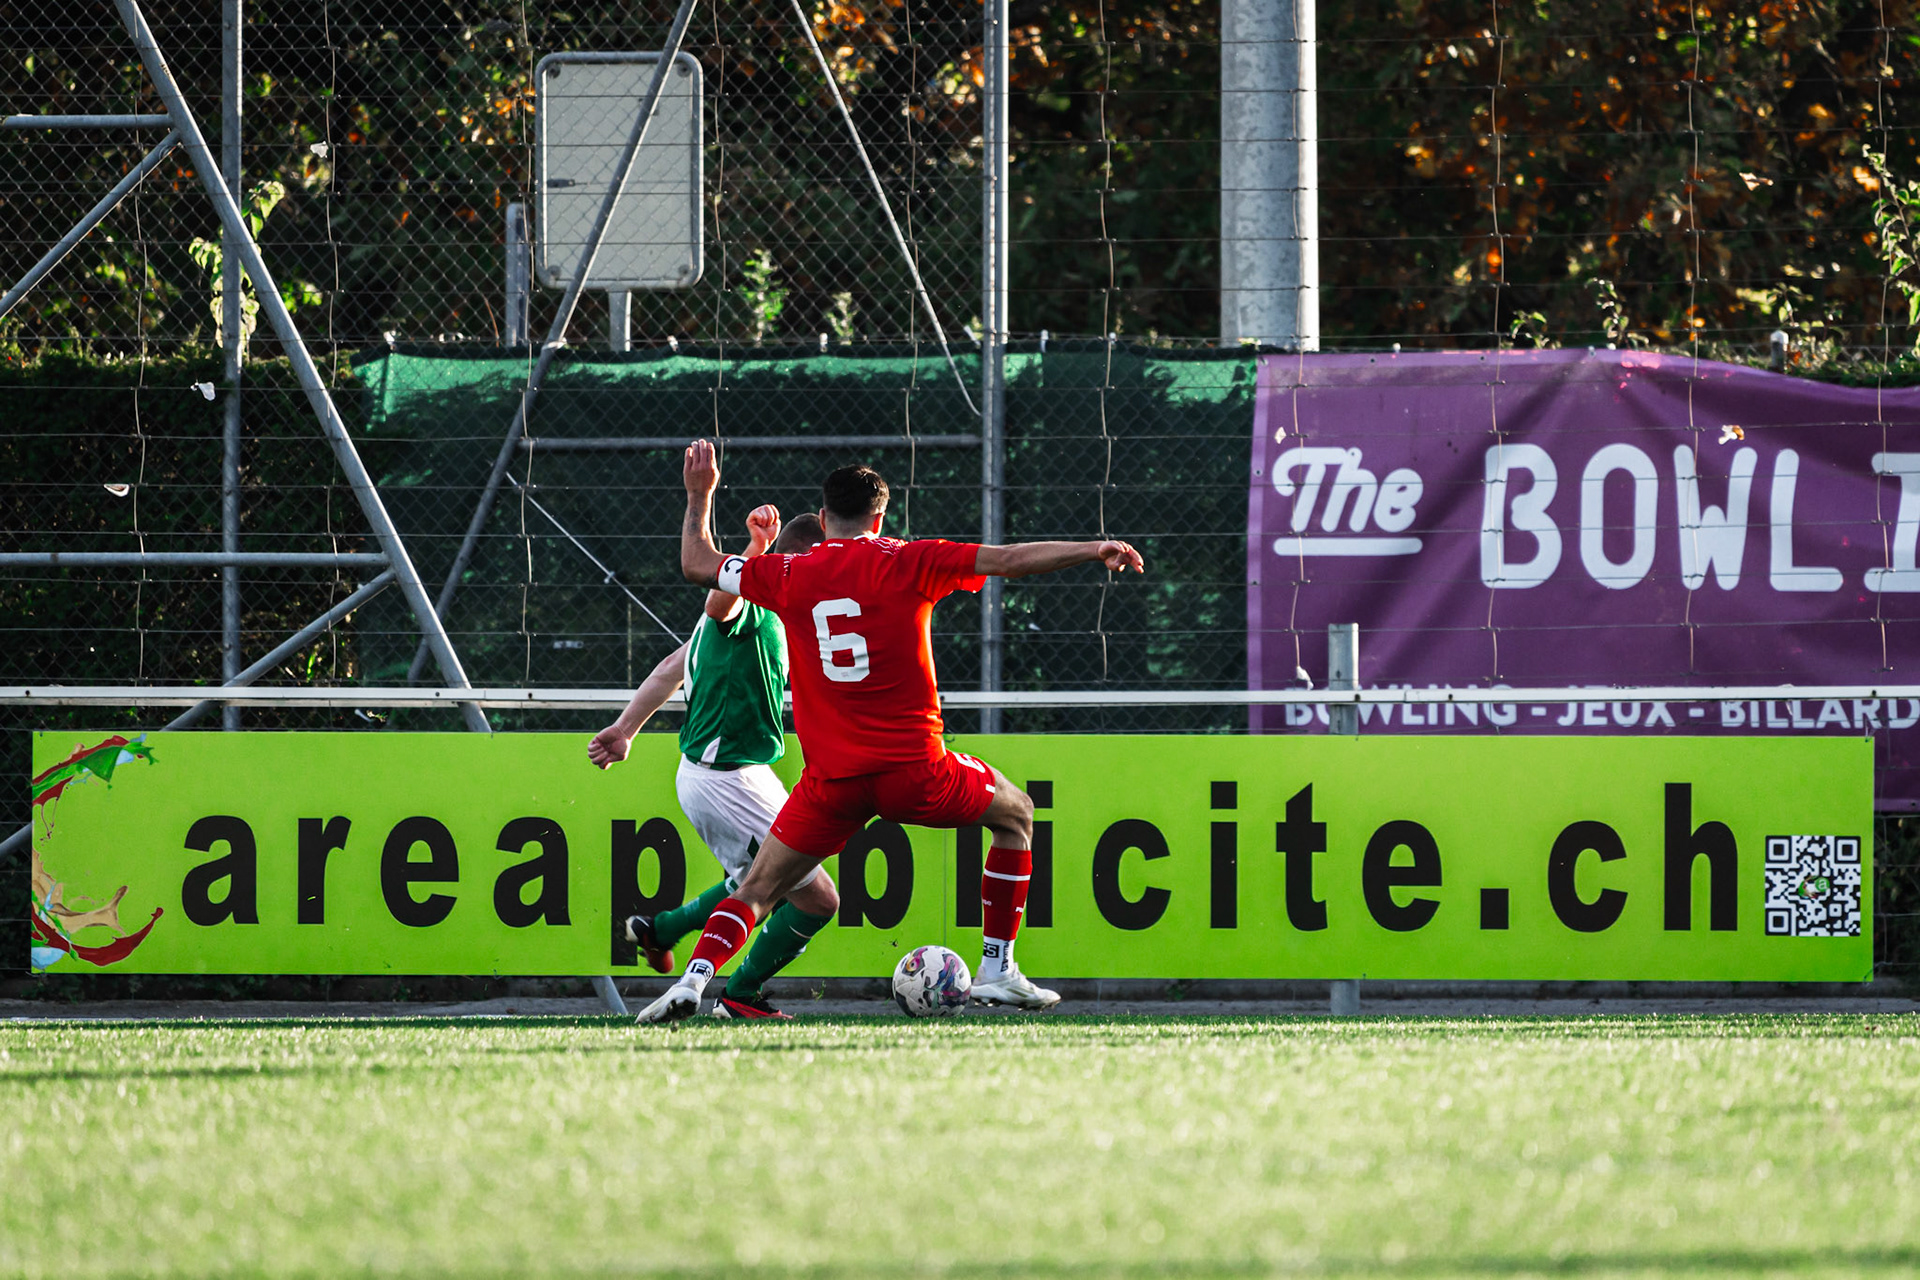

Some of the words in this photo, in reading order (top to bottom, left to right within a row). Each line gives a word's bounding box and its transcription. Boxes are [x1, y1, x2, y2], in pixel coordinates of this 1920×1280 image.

[1272, 447, 1424, 532] The
[812, 597, 870, 682] 6
[1285, 684, 1517, 727] BWLING
[181, 779, 1739, 967] areapblicite.ch
